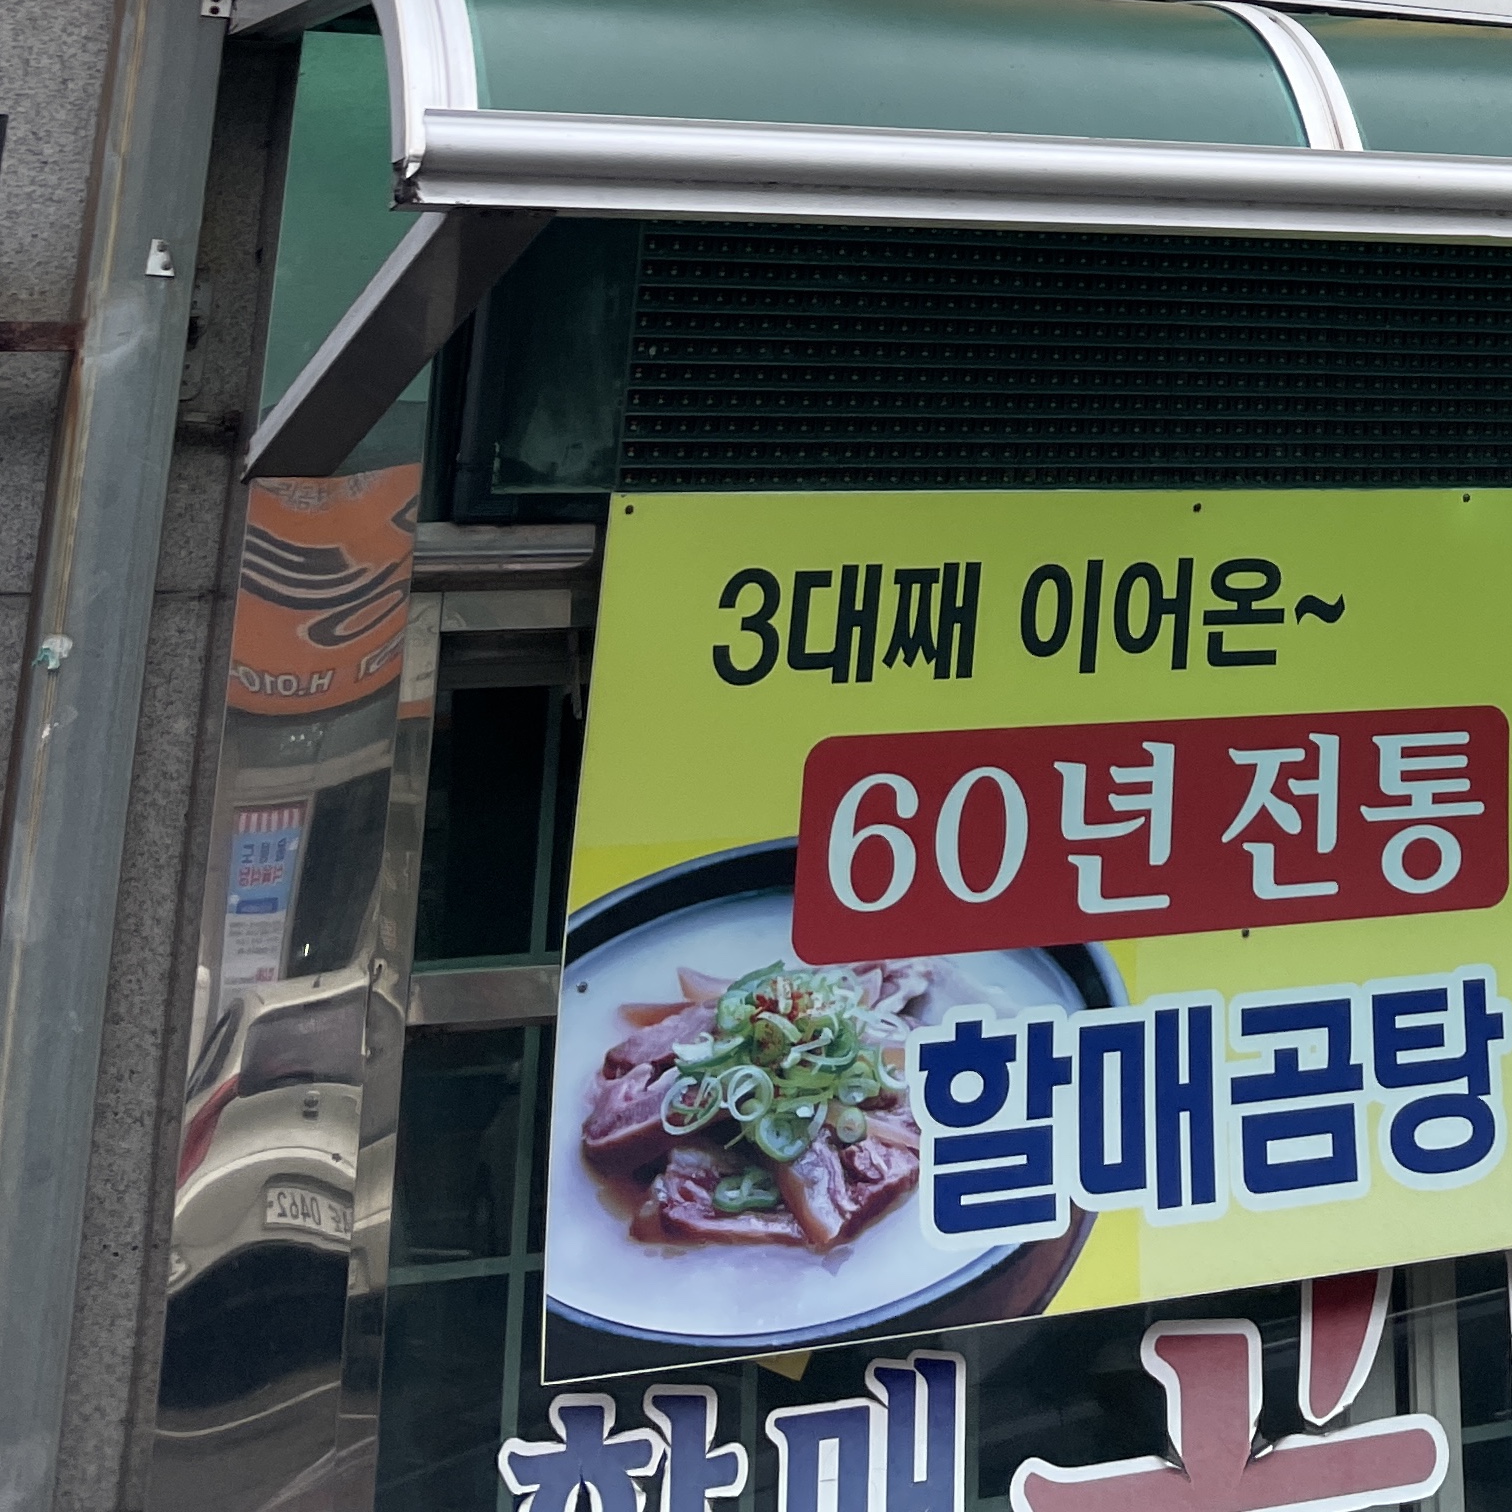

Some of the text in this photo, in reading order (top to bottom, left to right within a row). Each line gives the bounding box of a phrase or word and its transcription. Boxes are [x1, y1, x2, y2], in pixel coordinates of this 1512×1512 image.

[711, 556, 1347, 686] 3대째 이어온~
[826, 730, 1486, 915] 60년 전통
[918, 978, 1505, 1235] 할매곰탕
